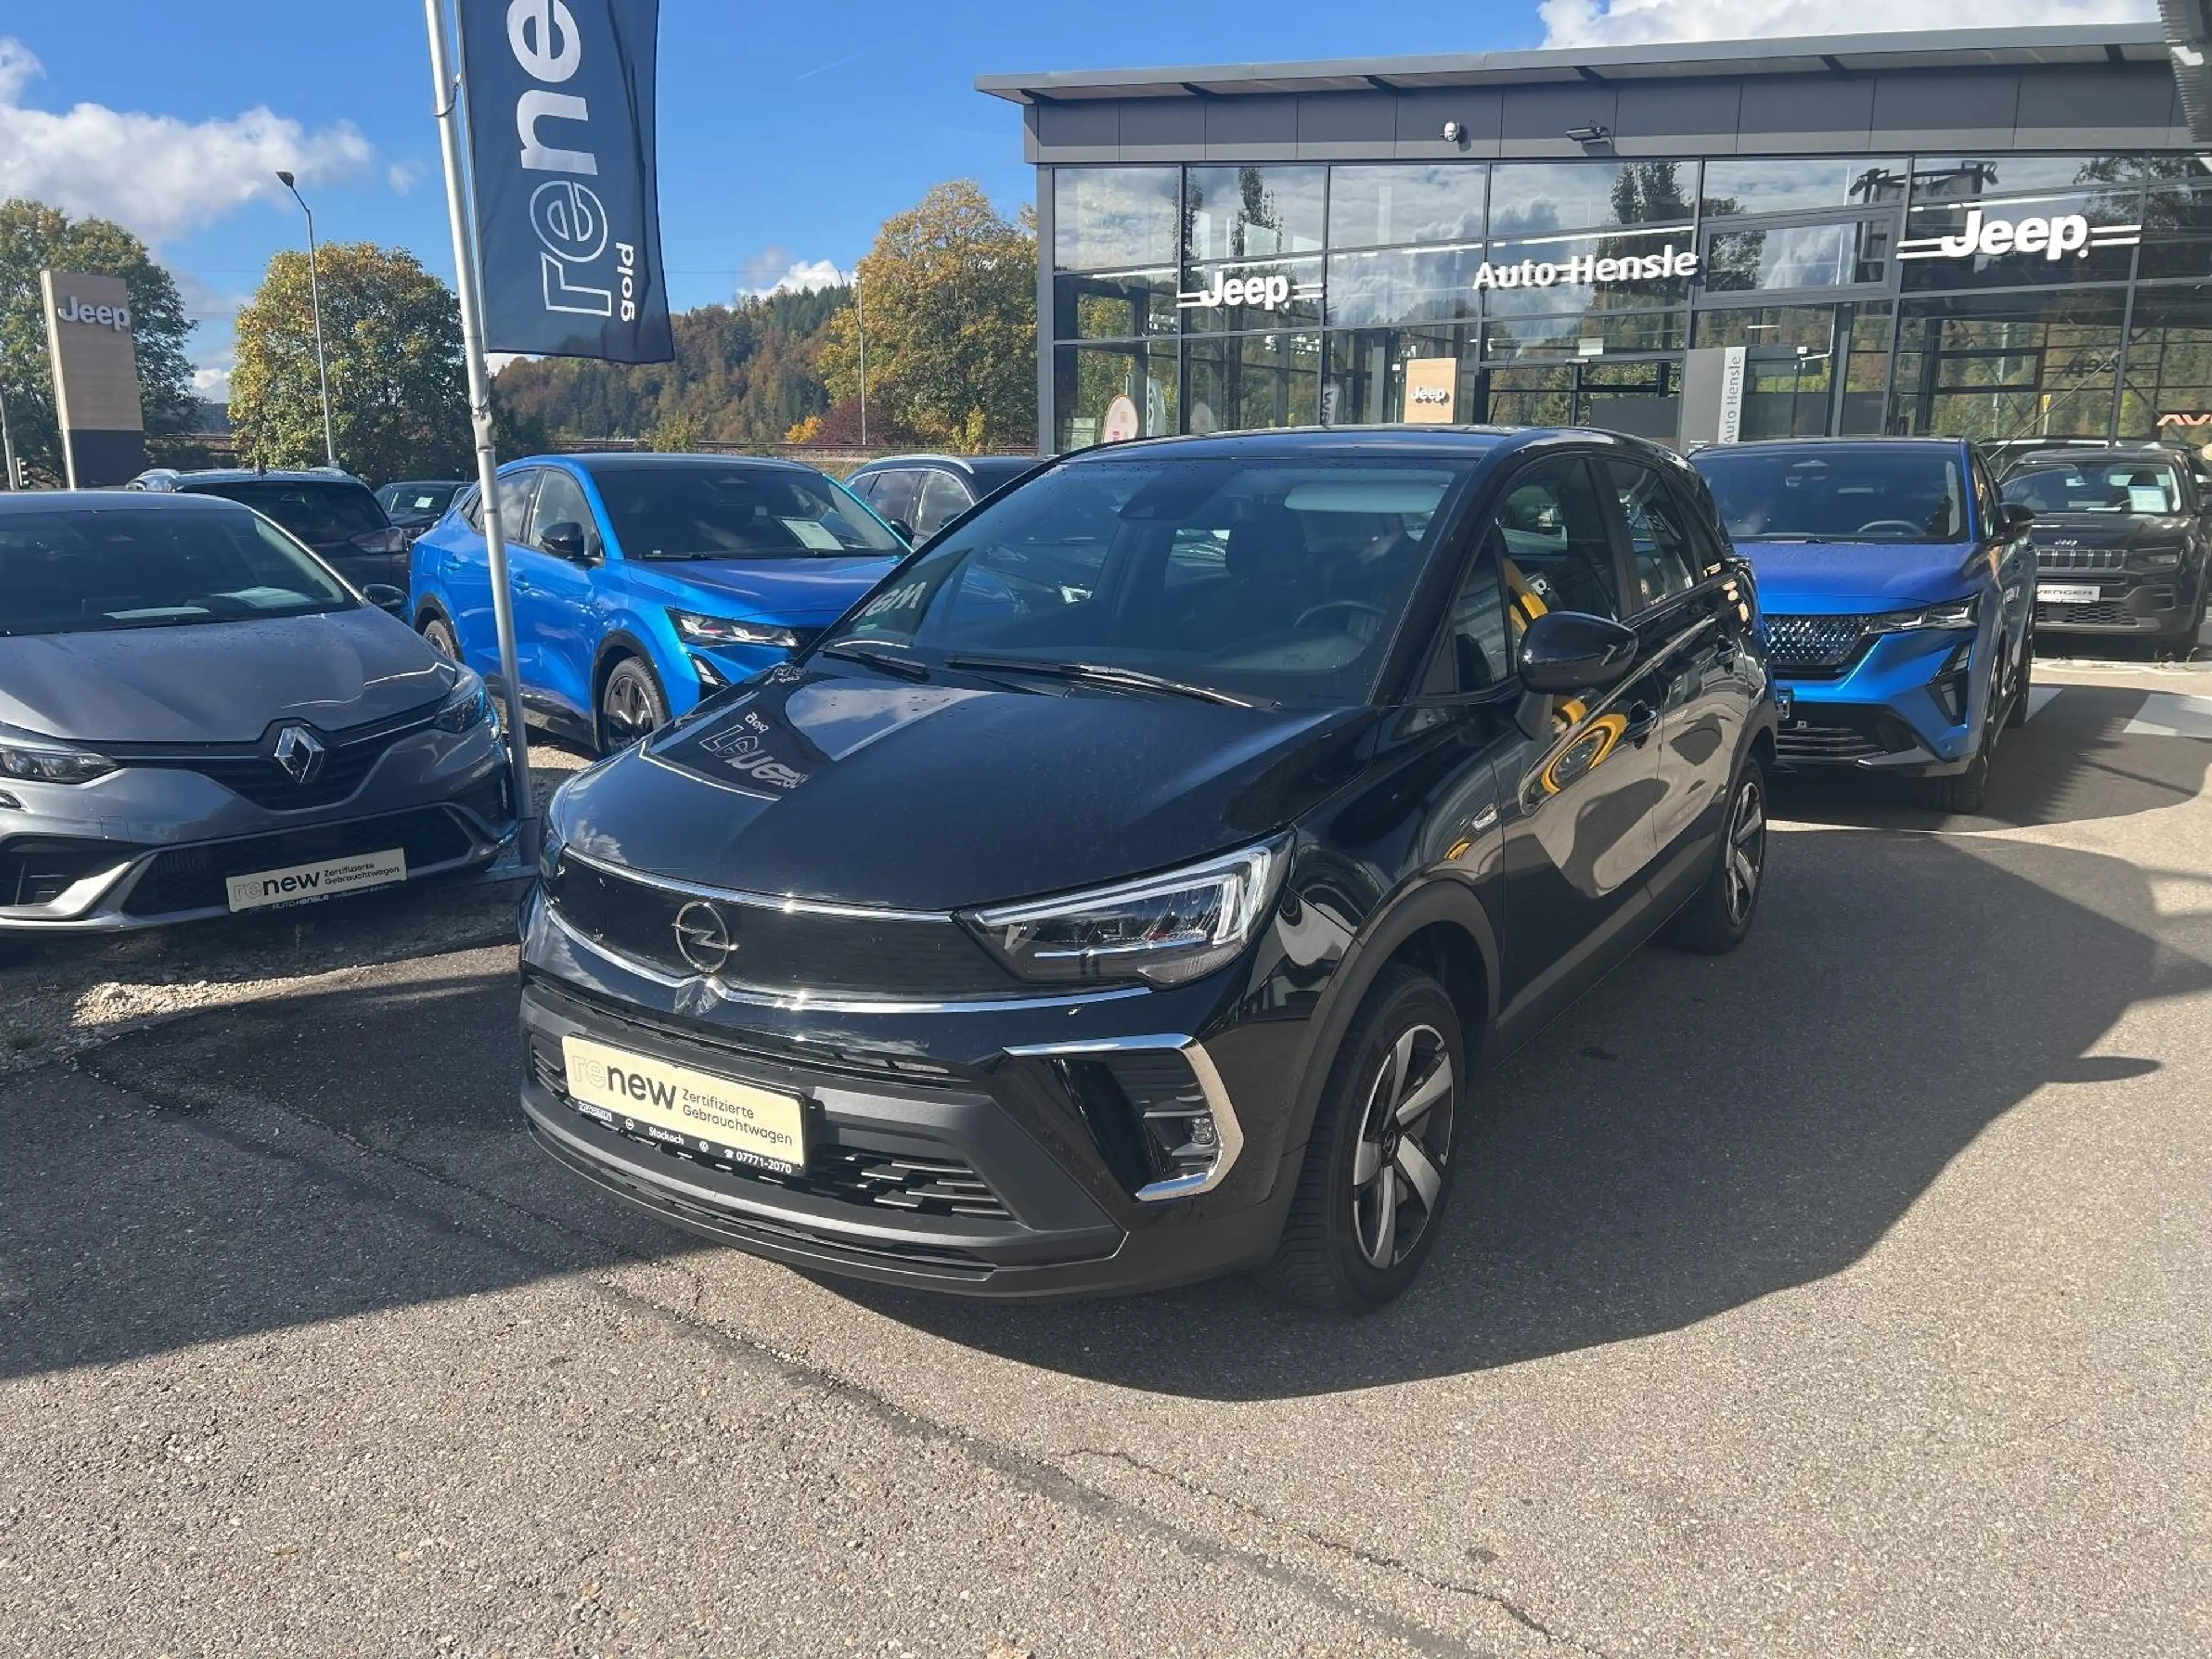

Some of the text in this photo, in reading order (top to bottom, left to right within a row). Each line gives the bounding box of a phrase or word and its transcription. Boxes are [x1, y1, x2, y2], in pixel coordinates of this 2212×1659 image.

[1941, 210, 2088, 261] Jeep
[616, 243, 635, 322] gold
[1570, 244, 1698, 283] Hensle
[1200, 271, 1290, 310] Jeep
[58, 295, 133, 331] Jeep
[1410, 385, 1446, 402] Jeep
[1723, 355, 1741, 443] Auto Hensle
[2156, 413, 2212, 426] AV
[233, 871, 320, 902] renew
[324, 863, 375, 878] Zertifizierte
[324, 866, 400, 885] Gebrauchtwagen
[571, 1055, 677, 1111] renew
[682, 1088, 755, 1119] Zertifizierte
[682, 1104, 793, 1146] Gebrauchtwagen
[648, 1126, 684, 1145] Stockach
[735, 1150, 793, 1175] 07771-2070
